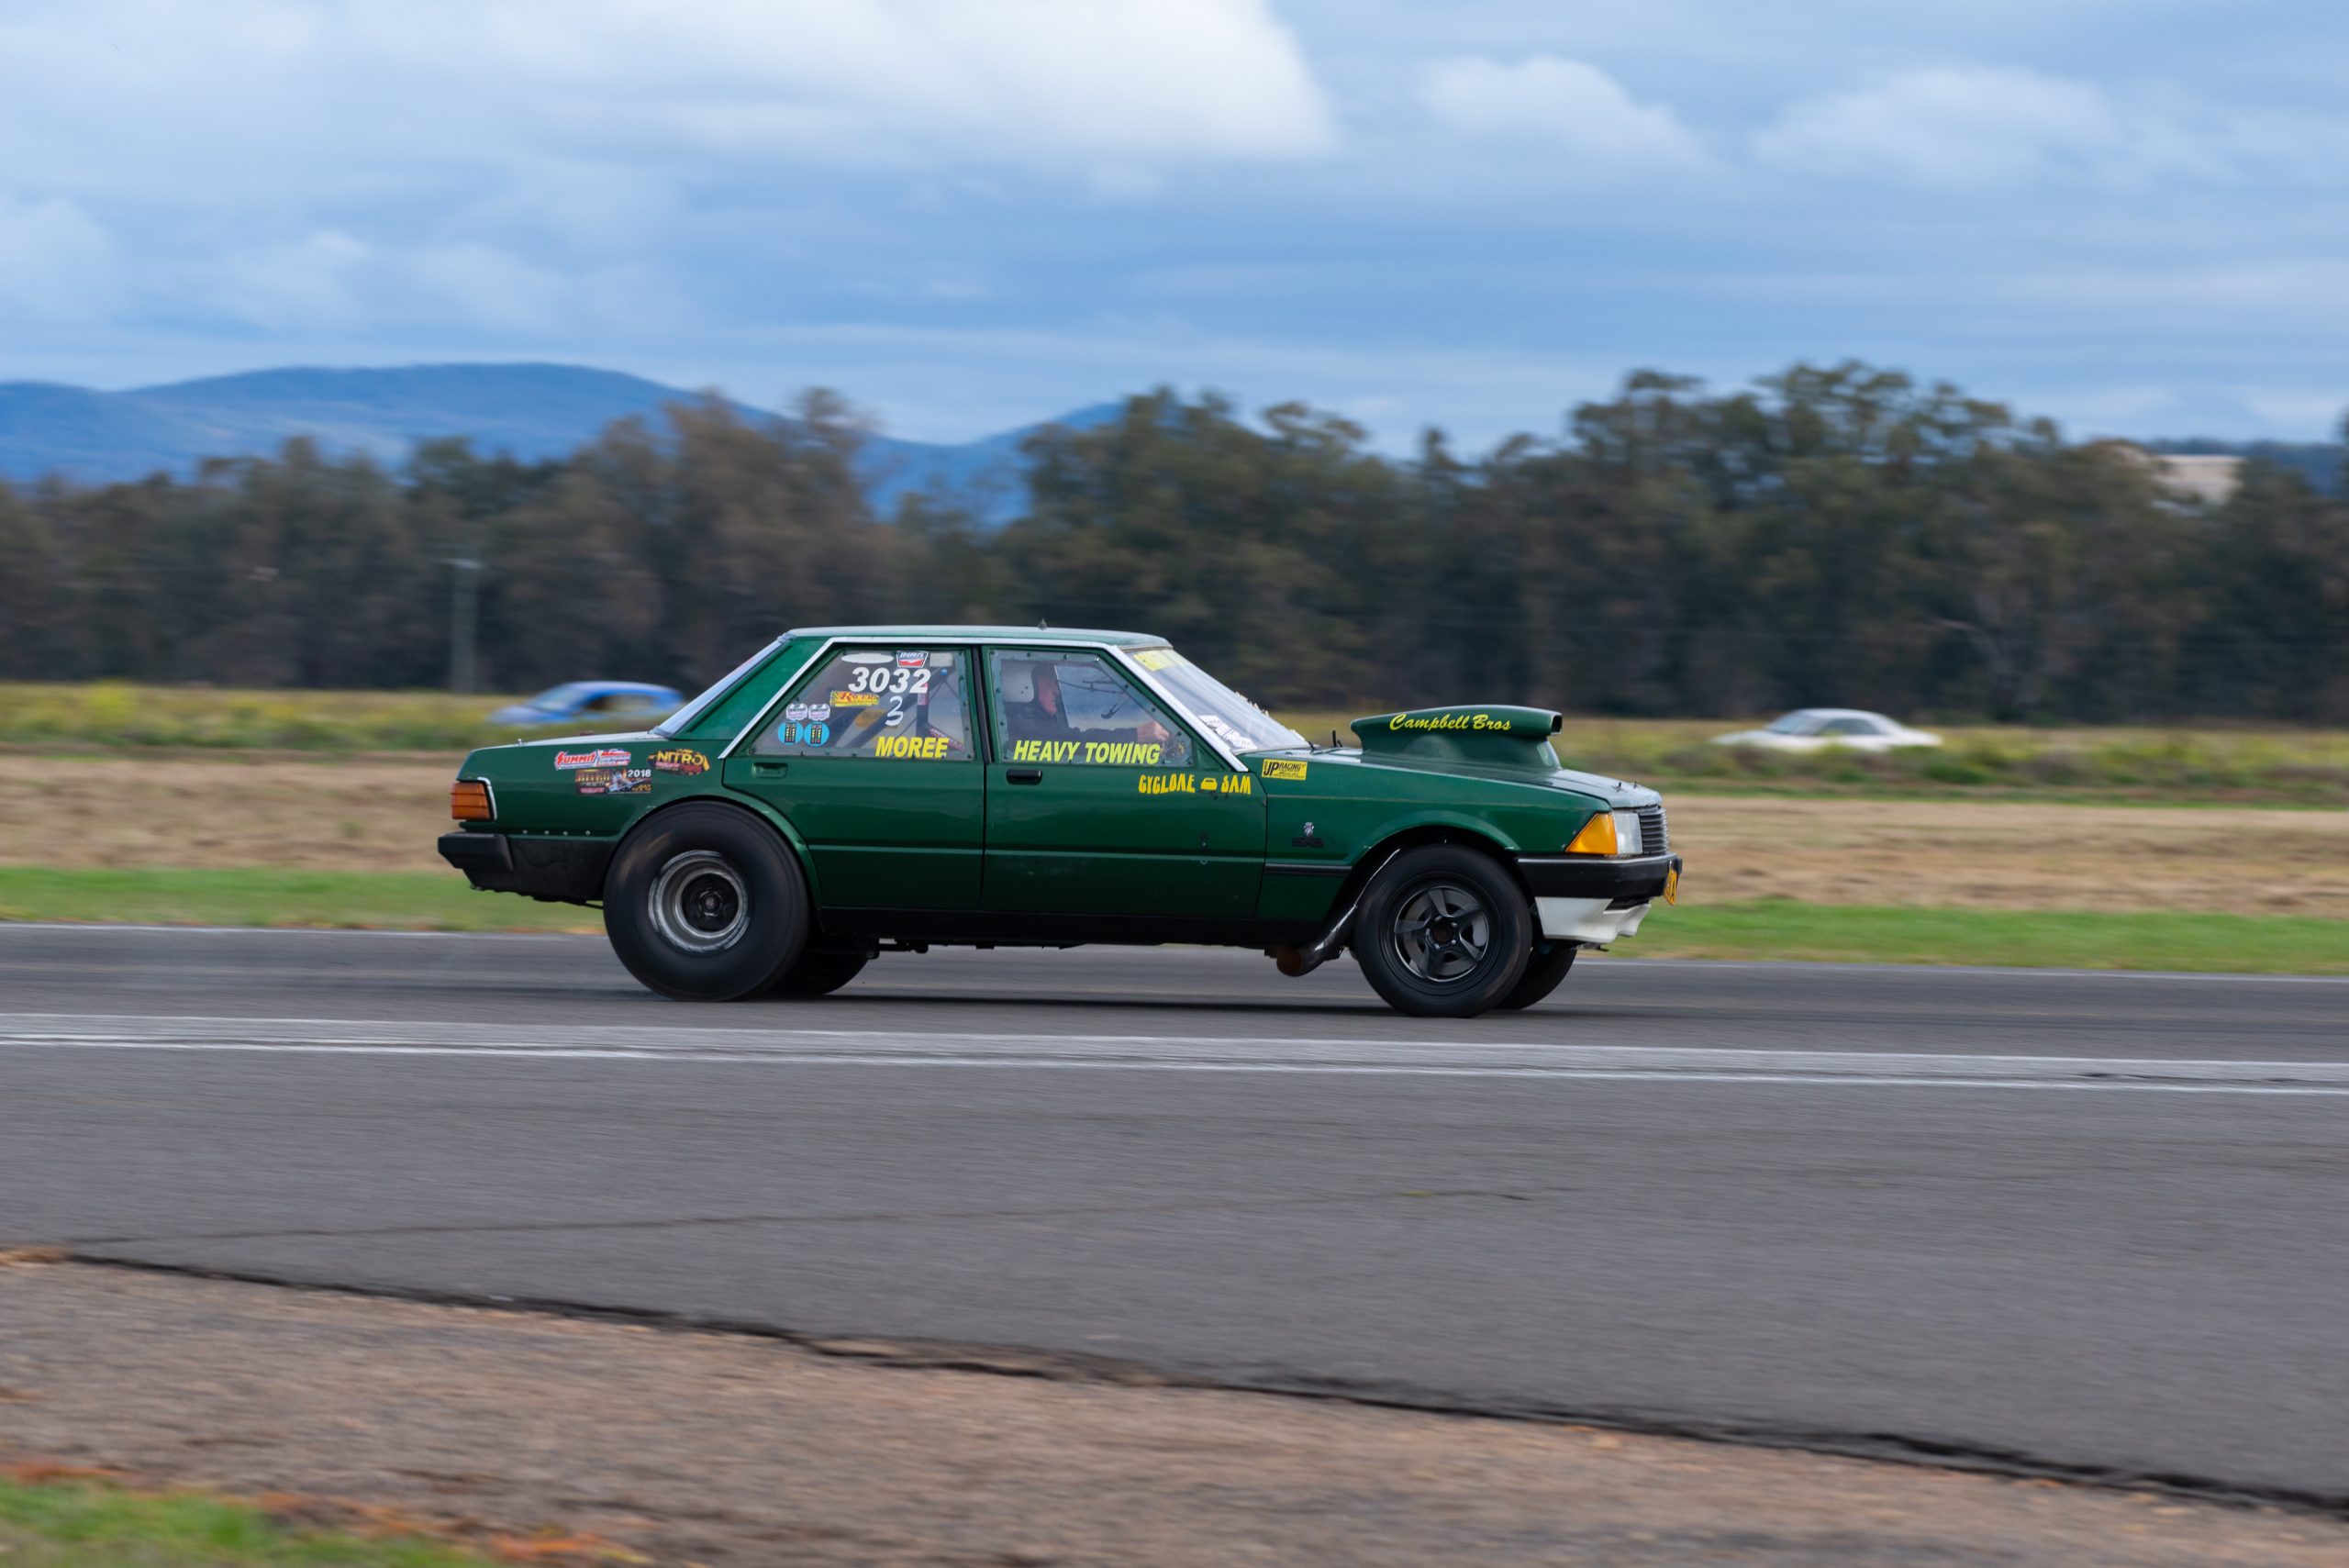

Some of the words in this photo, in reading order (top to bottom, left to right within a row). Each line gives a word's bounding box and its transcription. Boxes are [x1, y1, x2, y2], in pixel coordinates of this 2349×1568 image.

[848, 666, 931, 694] 3032
[1389, 713, 1470, 731] Campbell
[1472, 714, 1512, 730] Bros
[874, 736, 950, 758] MOREE
[1013, 740, 1081, 762] HEAVY
[1085, 741, 1161, 764] TOWING
[657, 751, 705, 765] NITRO
[627, 769, 651, 778] 2018
[1264, 762, 1279, 776] JP
[1279, 762, 1302, 771] RACING
[1220, 774, 1251, 795] SAM
